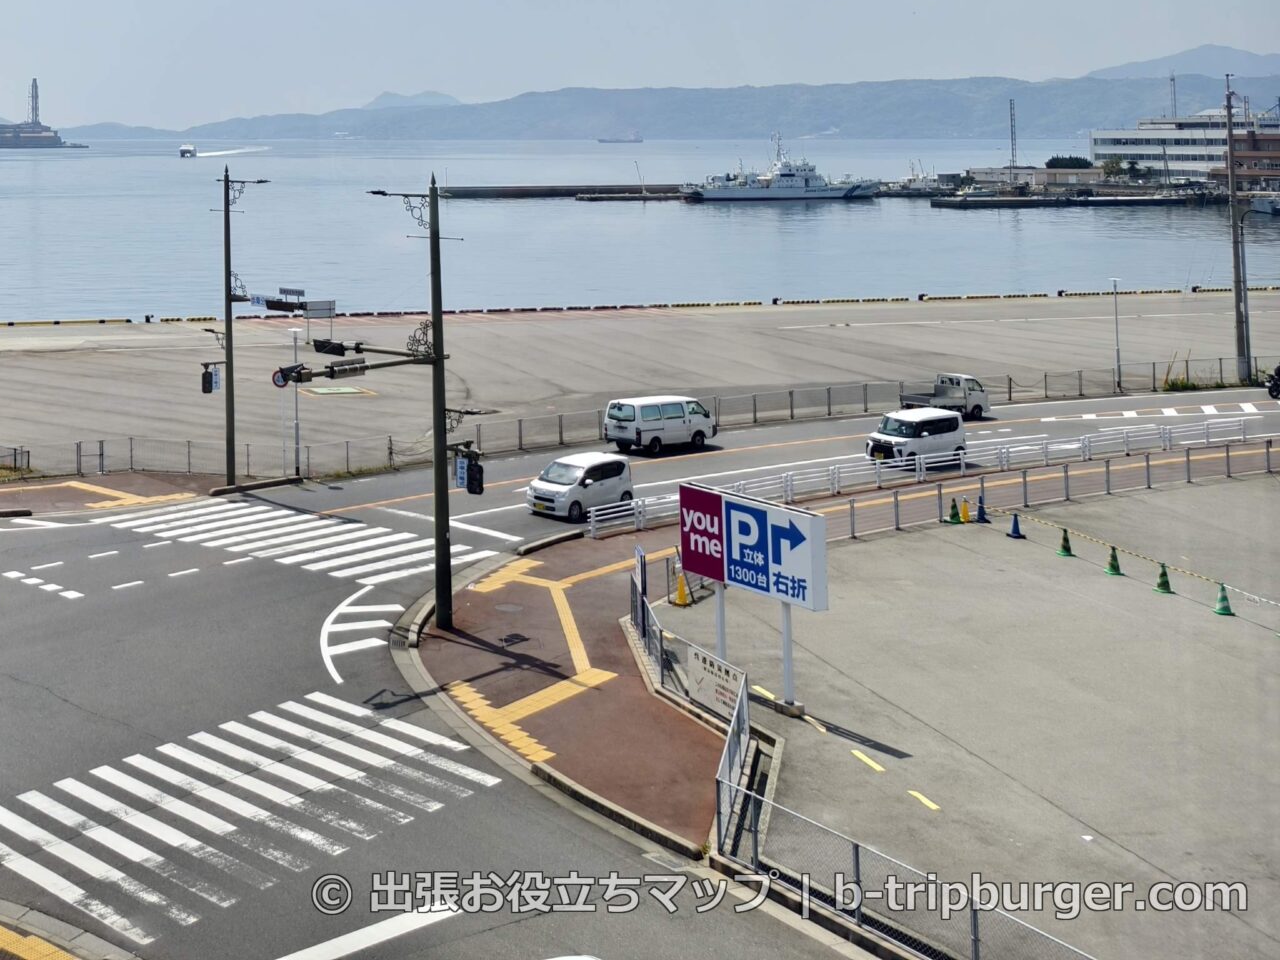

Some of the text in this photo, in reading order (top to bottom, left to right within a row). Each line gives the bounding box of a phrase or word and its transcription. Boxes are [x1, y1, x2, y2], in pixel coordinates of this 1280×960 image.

[682, 507, 719, 535] you
[690, 532, 722, 558] me
[730, 509, 759, 561] P
[743, 548, 765, 567] 立体
[729, 565, 767, 588] 1300台
[772, 571, 807, 602] 右折
